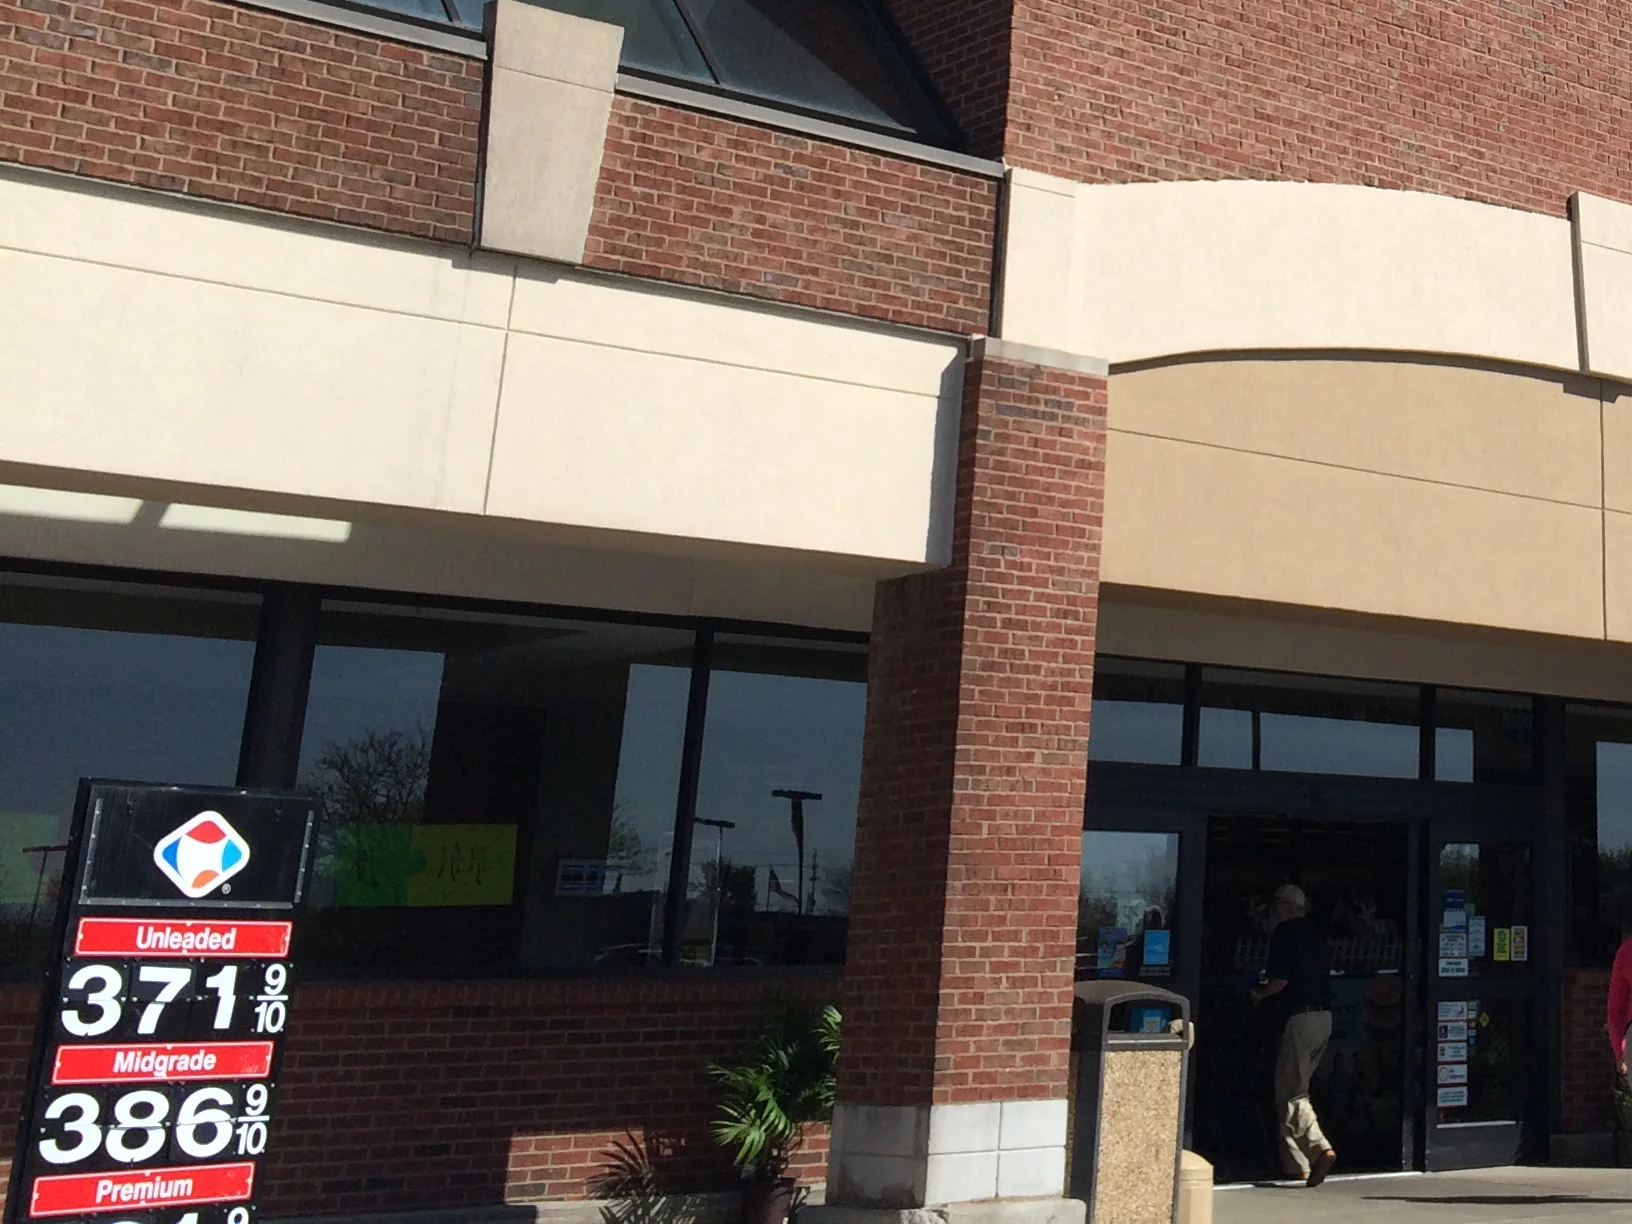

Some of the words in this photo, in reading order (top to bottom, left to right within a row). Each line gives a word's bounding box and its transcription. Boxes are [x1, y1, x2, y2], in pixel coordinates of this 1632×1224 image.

[136, 926, 237, 950] Unleaded
[61, 964, 239, 1037] 371
[113, 1051, 216, 1077] Midgrade
[38, 1087, 234, 1164] 386
[96, 1176, 193, 1204] Premium
